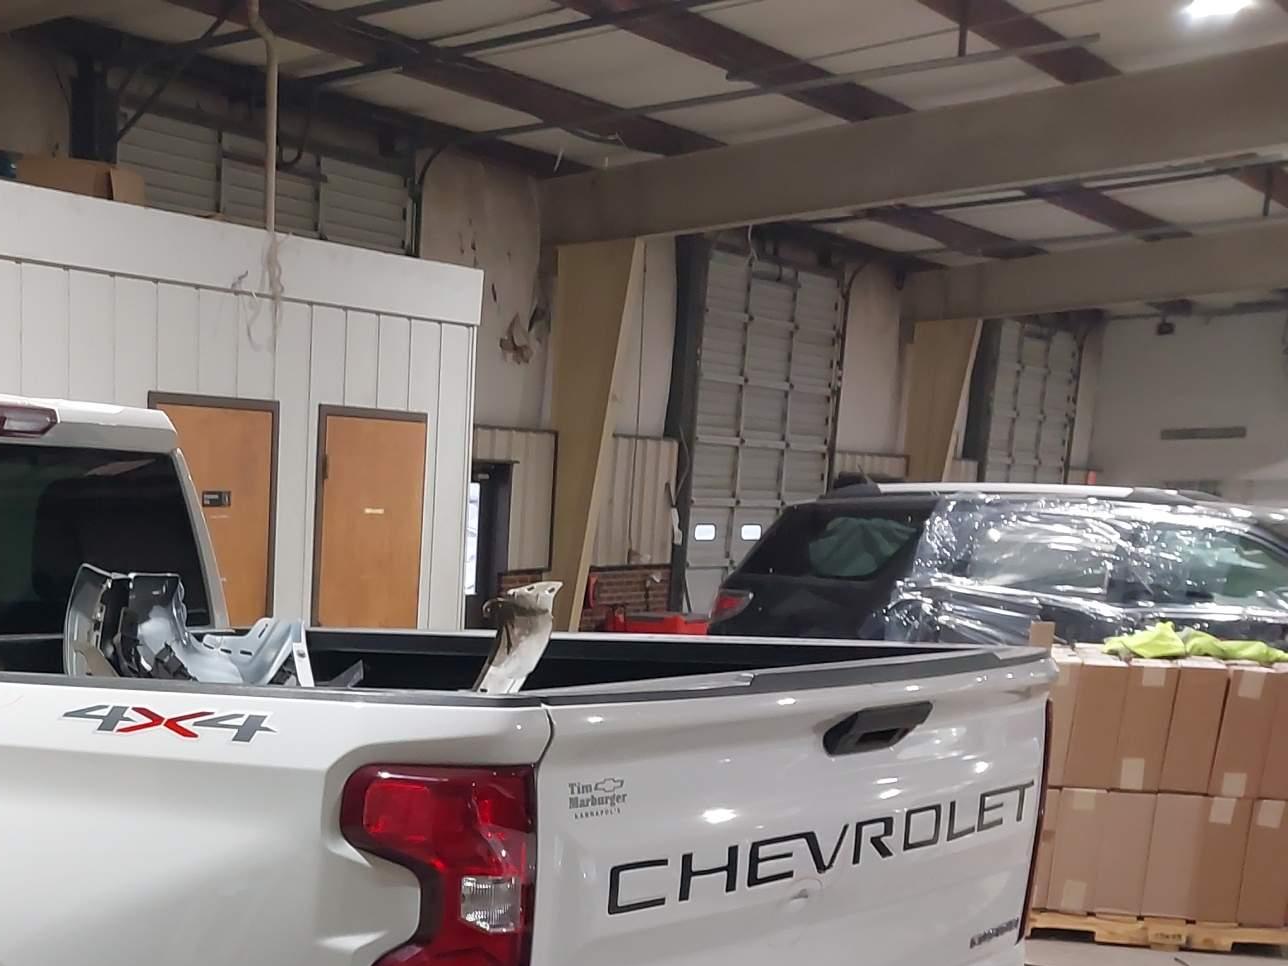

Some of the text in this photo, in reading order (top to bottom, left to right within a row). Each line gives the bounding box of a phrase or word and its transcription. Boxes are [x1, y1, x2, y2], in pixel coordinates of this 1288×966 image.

[568, 782, 593, 795] Tim
[569, 793, 628, 809] Marburger
[608, 780, 1034, 915] CHEVROLET
